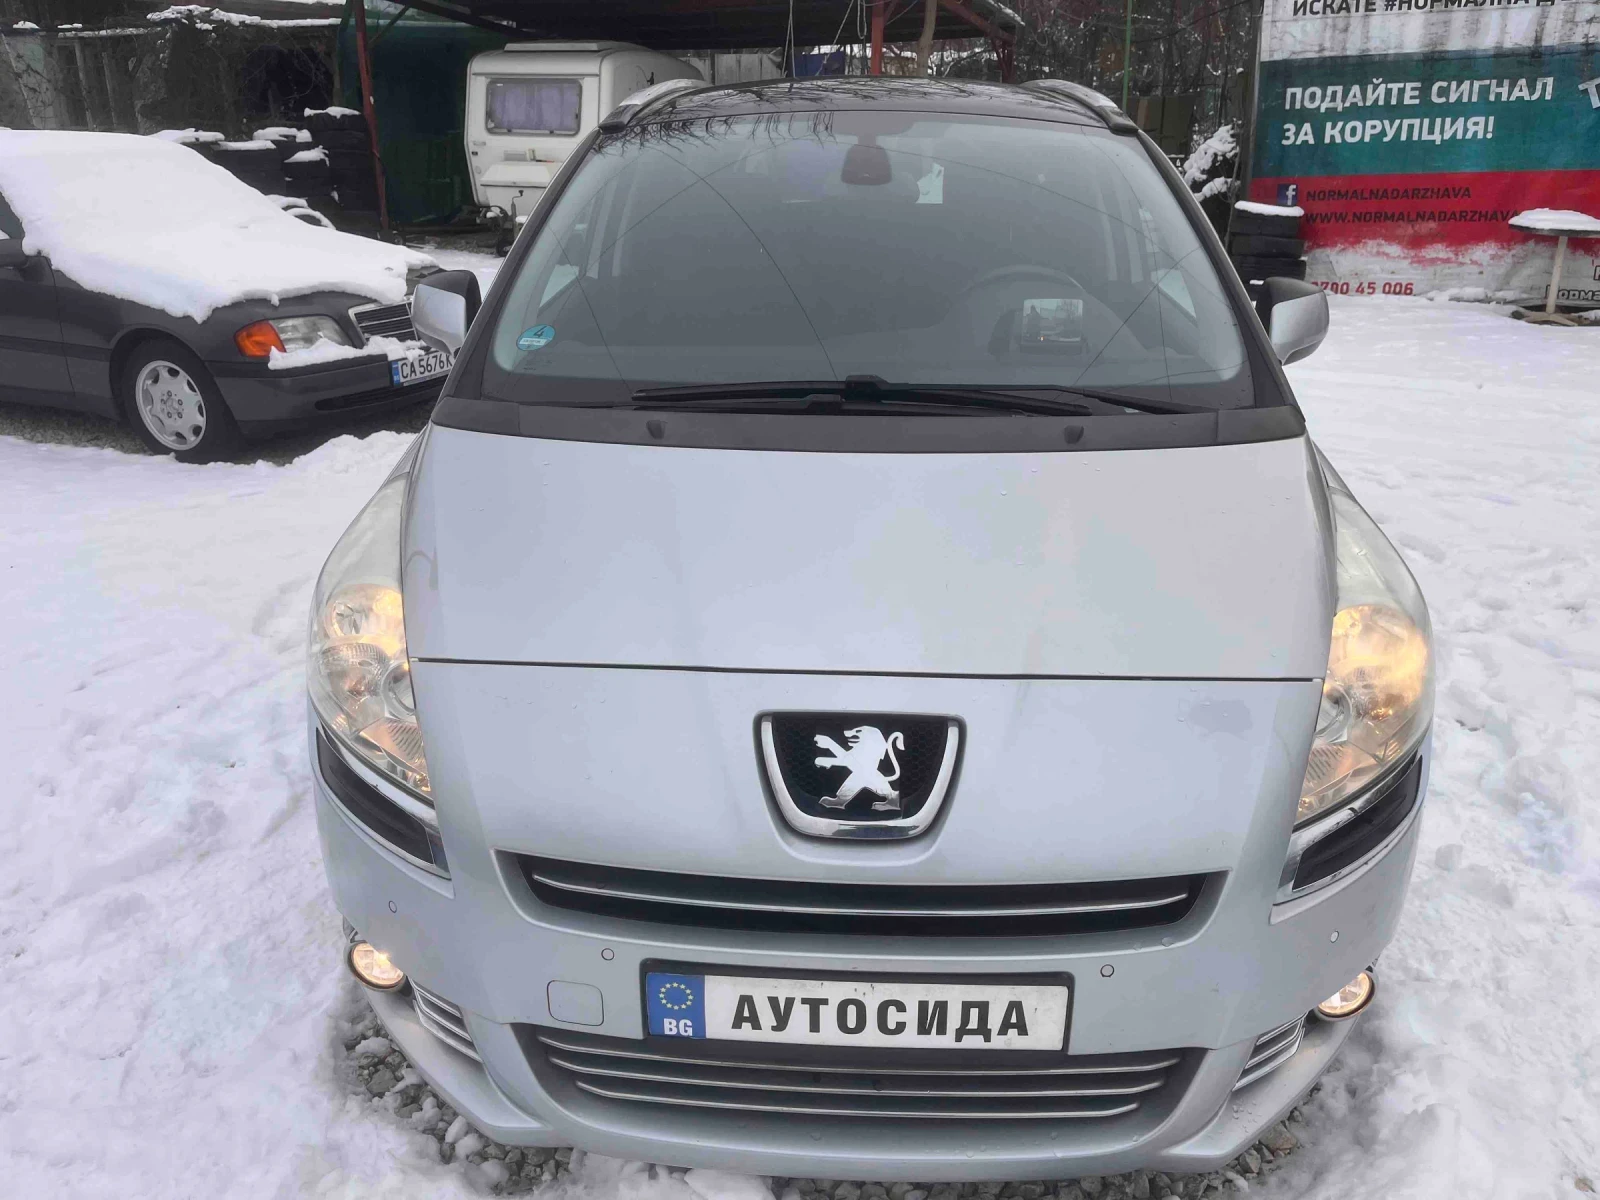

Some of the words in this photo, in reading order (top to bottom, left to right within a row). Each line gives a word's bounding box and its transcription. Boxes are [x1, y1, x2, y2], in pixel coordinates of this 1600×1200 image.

[1285, 78, 1421, 113] ПОДАЙТЕ
[1430, 77, 1554, 104] СИГНАЛ
[1281, 123, 1315, 146] ЗА
[1324, 116, 1495, 144] КОРУПЦИЯ!
[1306, 186, 1472, 202] NORMALNADARZHAVA
[1355, 281, 1376, 295] 45
[1382, 282, 1414, 296] 006
[663, 1018, 693, 1037] BG
[731, 993, 1030, 1043] АУТОСИДА
